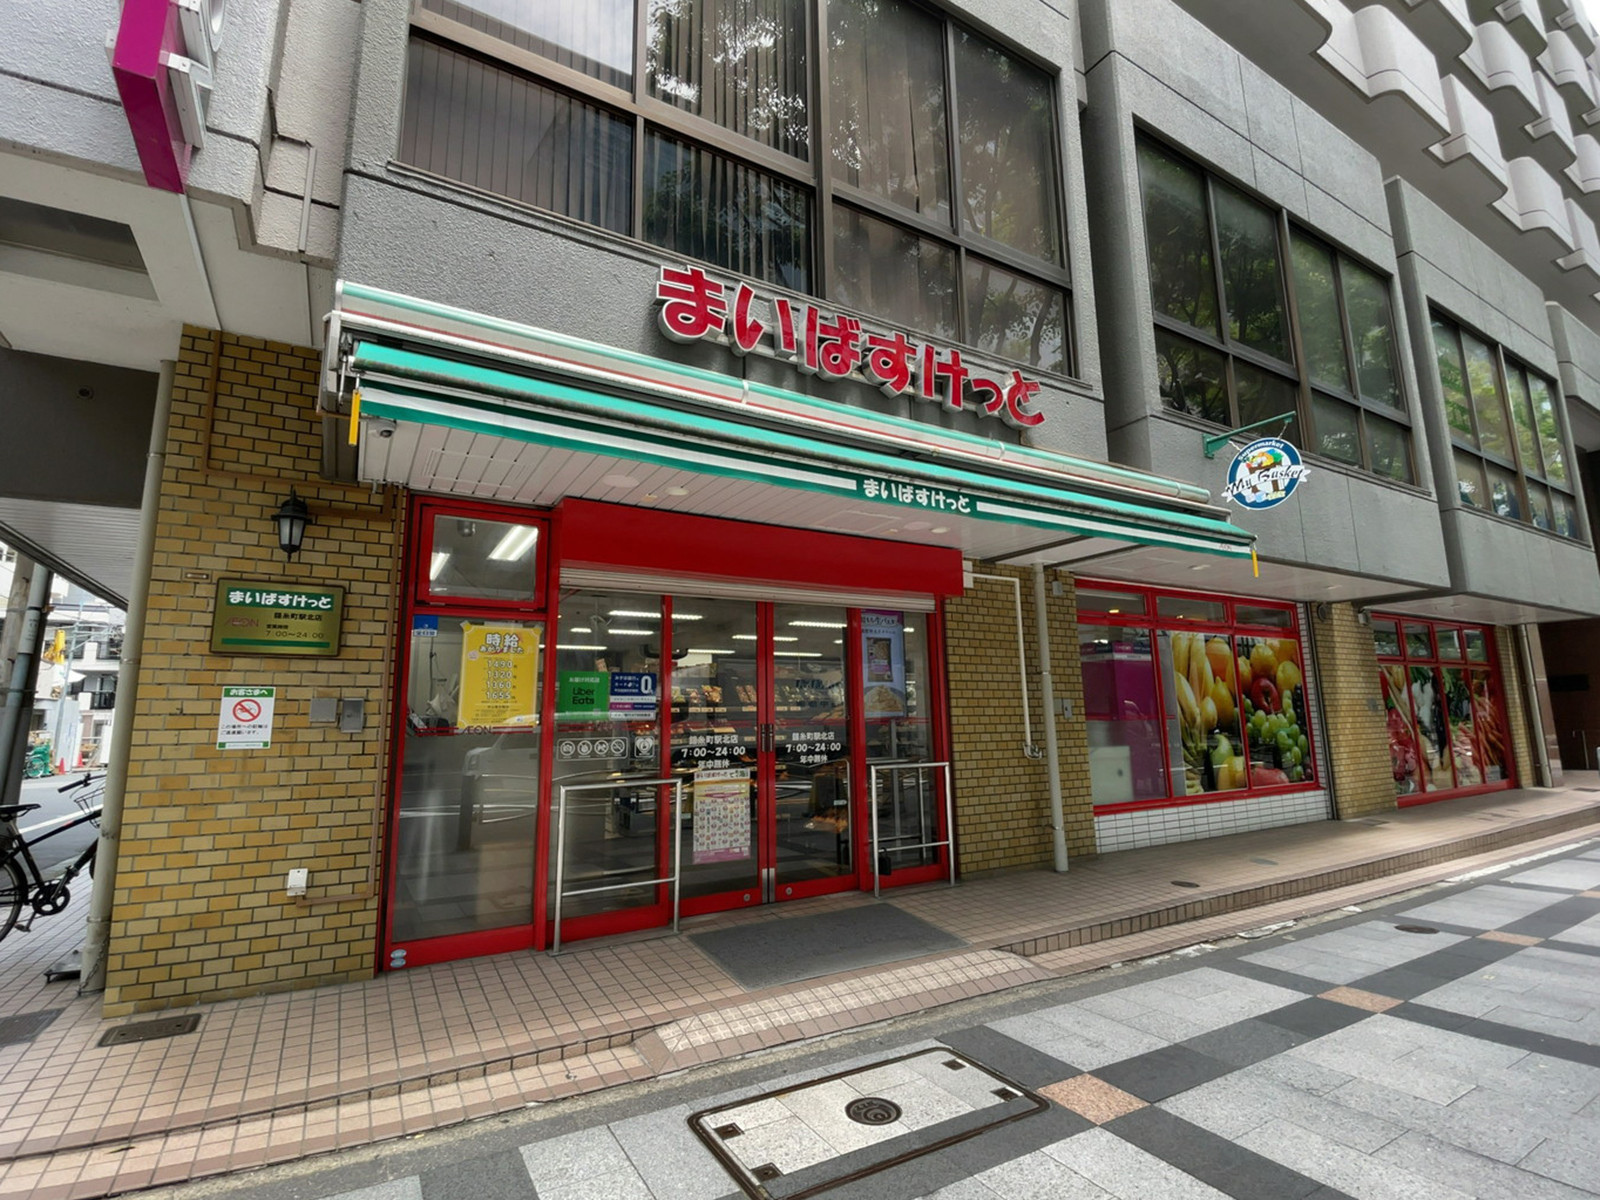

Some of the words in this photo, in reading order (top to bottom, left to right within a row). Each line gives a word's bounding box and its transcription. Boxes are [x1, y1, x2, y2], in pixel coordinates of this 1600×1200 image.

[656, 264, 1046, 427] まいばすけっと
[1238, 440, 1285, 461] Supermarket
[863, 478, 972, 514] まいばすけっと
[228, 590, 332, 609] まいばすけっと
[485, 633, 520, 647] 時給
[572, 687, 595, 696] Uber
[572, 696, 595, 705] Eats
